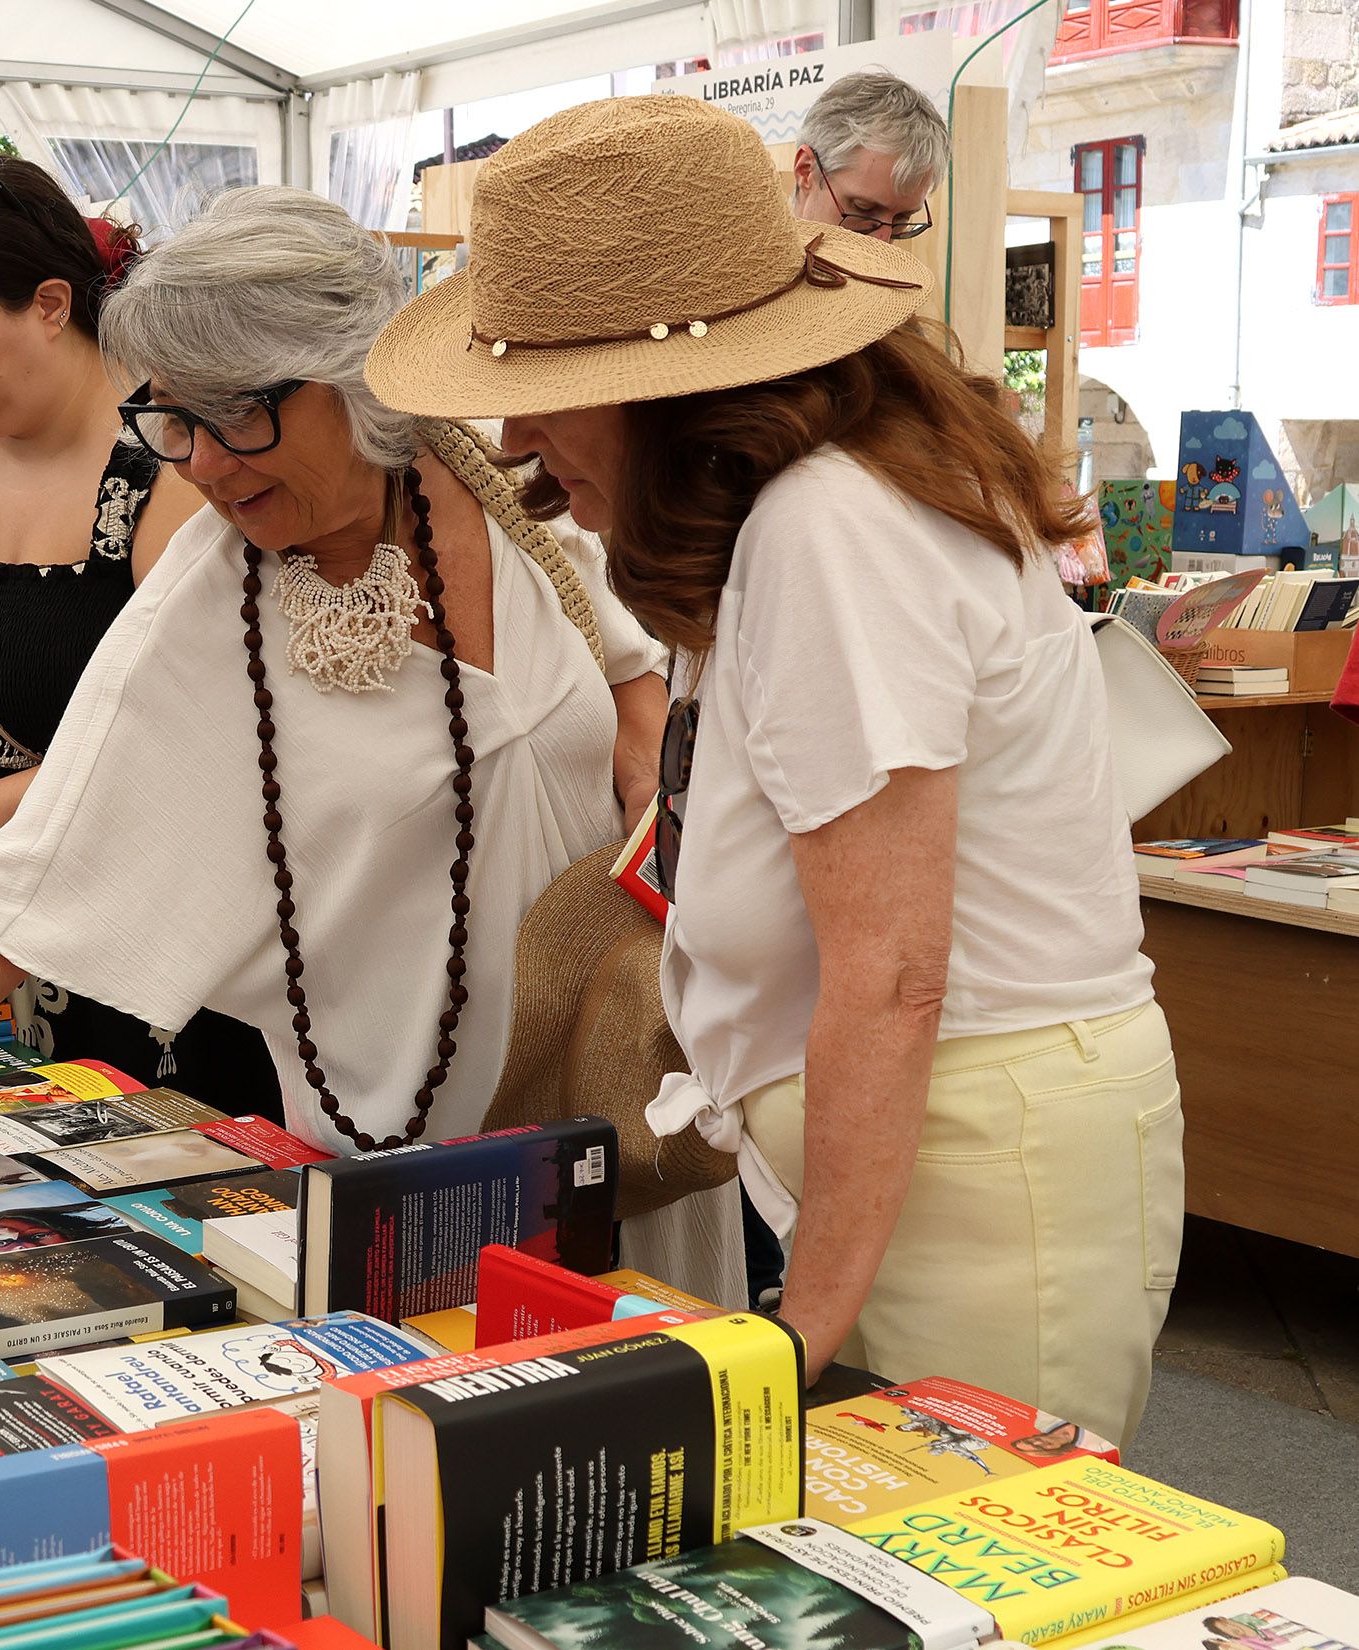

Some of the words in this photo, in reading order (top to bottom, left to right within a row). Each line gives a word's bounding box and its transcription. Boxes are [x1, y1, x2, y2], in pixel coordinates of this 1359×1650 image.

[703, 68, 784, 100] LIBRARÍA
[789, 64, 824, 88] PAZ
[727, 101, 764, 117] Peregrina,
[764, 98, 775, 110] 29
[94, 1173, 119, 1186] Alex
[130, 1202, 168, 1224] CORUJO
[207, 1198, 239, 1217] HAN
[210, 1187, 268, 1214] ANTADO
[240, 1188, 291, 1212] BINGO
[167, 1221, 192, 1236] LANA
[113, 1239, 138, 1252] GRITO
[133, 1260, 150, 1271] Sosa
[148, 1270, 164, 1281] Ruiz
[158, 1262, 183, 1283] PAISAJE
[161, 1280, 181, 1293] Eduardo
[182, 1280, 197, 1291] EL
[54, 1329, 82, 1340] PAISAJE
[94, 1323, 110, 1331] Sosa
[111, 1320, 124, 1329] Ruiz
[125, 1316, 149, 1327] Eduardo
[7, 1338, 29, 1348] GRITO
[30, 1336, 41, 1345] UN
[42, 1334, 52, 1342] ES
[147, 1349, 193, 1382] cuando
[158, 1341, 207, 1367] dormir
[375, 1352, 484, 1381] ELISABET
[119, 1355, 202, 1414] antandreu
[205, 1367, 264, 1404] puedes
[386, 1358, 502, 1388] BENAVENT
[419, 1357, 581, 1403] MENTIRA
[576, 1349, 613, 1364] JUAN
[105, 1371, 167, 1411] Rafael
[191, 1381, 234, 1409] ormir
[718, 1368, 733, 1427] INTERNACIONAL
[40, 1389, 90, 1421] GARAT
[743, 1409, 752, 1427] TIMES
[721, 1427, 733, 1456] CRÍTICA
[743, 1427, 752, 1443] YORK
[668, 1446, 685, 1472] ASÍ.
[723, 1457, 733, 1467] LA
[743, 1443, 752, 1455] NEW
[744, 1455, 752, 1467] THE
[554, 1446, 564, 1497] inminente
[588, 1459, 596, 1478] vas
[599, 1446, 608, 1494] personas.
[618, 1464, 626, 1489] visto
[650, 1448, 667, 1496] RAMOS.
[723, 1467, 733, 1483] POR
[805, 1456, 869, 1493] CON
[566, 1465, 576, 1504] verdad.
[1080, 1475, 1111, 1491] DEL
[1083, 1466, 1170, 1504] ANTIGUO
[514, 1487, 524, 1528] hacerlo.
[535, 1470, 546, 1531] inteligencia.
[587, 1478, 597, 1515] aunque
[598, 1495, 606, 1520] otras
[617, 1488, 626, 1507] has
[628, 1488, 639, 1520] igual.
[649, 1496, 666, 1518] EVA
[667, 1472, 684, 1535] LLAMARME
[721, 1484, 733, 1521] ACLAMADO
[1110, 1483, 1197, 1523] IMPACTO
[555, 1497, 564, 1531] muerte
[566, 1505, 575, 1515] la
[618, 1507, 625, 1519] no
[1035, 1485, 1182, 1544] FILTROS
[1041, 1508, 1114, 1538] SIN
[1167, 1498, 1241, 1529] MUNDO
[503, 1513, 512, 1549] mentir.
[535, 1530, 543, 1540] tu
[553, 1533, 562, 1543] la
[565, 1515, 577, 1537] diga
[585, 1515, 595, 1559] mentirte,
[616, 1520, 625, 1540] que
[627, 1519, 636, 1543] nada
[647, 1518, 664, 1558] LLAMO
[959, 1495, 1134, 1569] CLÁSICOS
[1195, 1519, 1216, 1531] EL
[503, 1550, 511, 1561] es
[515, 1537, 525, 1554] voy
[565, 1538, 573, 1549] te
[596, 1528, 605, 1559] mentir
[626, 1544, 635, 1567] nunca
[758, 1529, 809, 1557] ASTURIAS
[903, 1513, 1082, 1590] BEARD
[515, 1555, 522, 1567] no
[531, 1541, 543, 1593] demasiado
[553, 1551, 562, 1580] miedo
[565, 1550, 574, 1567] que
[803, 1542, 890, 1588] COMUNICACIÓN
[809, 1555, 828, 1567] DE
[824, 1541, 902, 1583] HUMANIDADES
[860, 1530, 1029, 1603] MARY
[866, 1553, 895, 1569] 2025
[1197, 1552, 1259, 1584] CLÁSICOS
[500, 1559, 512, 1596] trabajo
[513, 1568, 523, 1600] ontigo
[829, 1567, 884, 1597] PRINCESA
[1175, 1579, 1197, 1594] SIN
[669, 1586, 725, 1622] Chul
[716, 1581, 749, 1602] WEIL
[890, 1587, 909, 1599] DE
[1127, 1585, 1175, 1611] FILTROS
[744, 1598, 782, 1625] SIMONE
[883, 1593, 933, 1626] PREMIO
[1071, 1604, 1109, 1630] MARY
[675, 1617, 711, 1645] Sobre
[1020, 1618, 1072, 1643] BEARD
